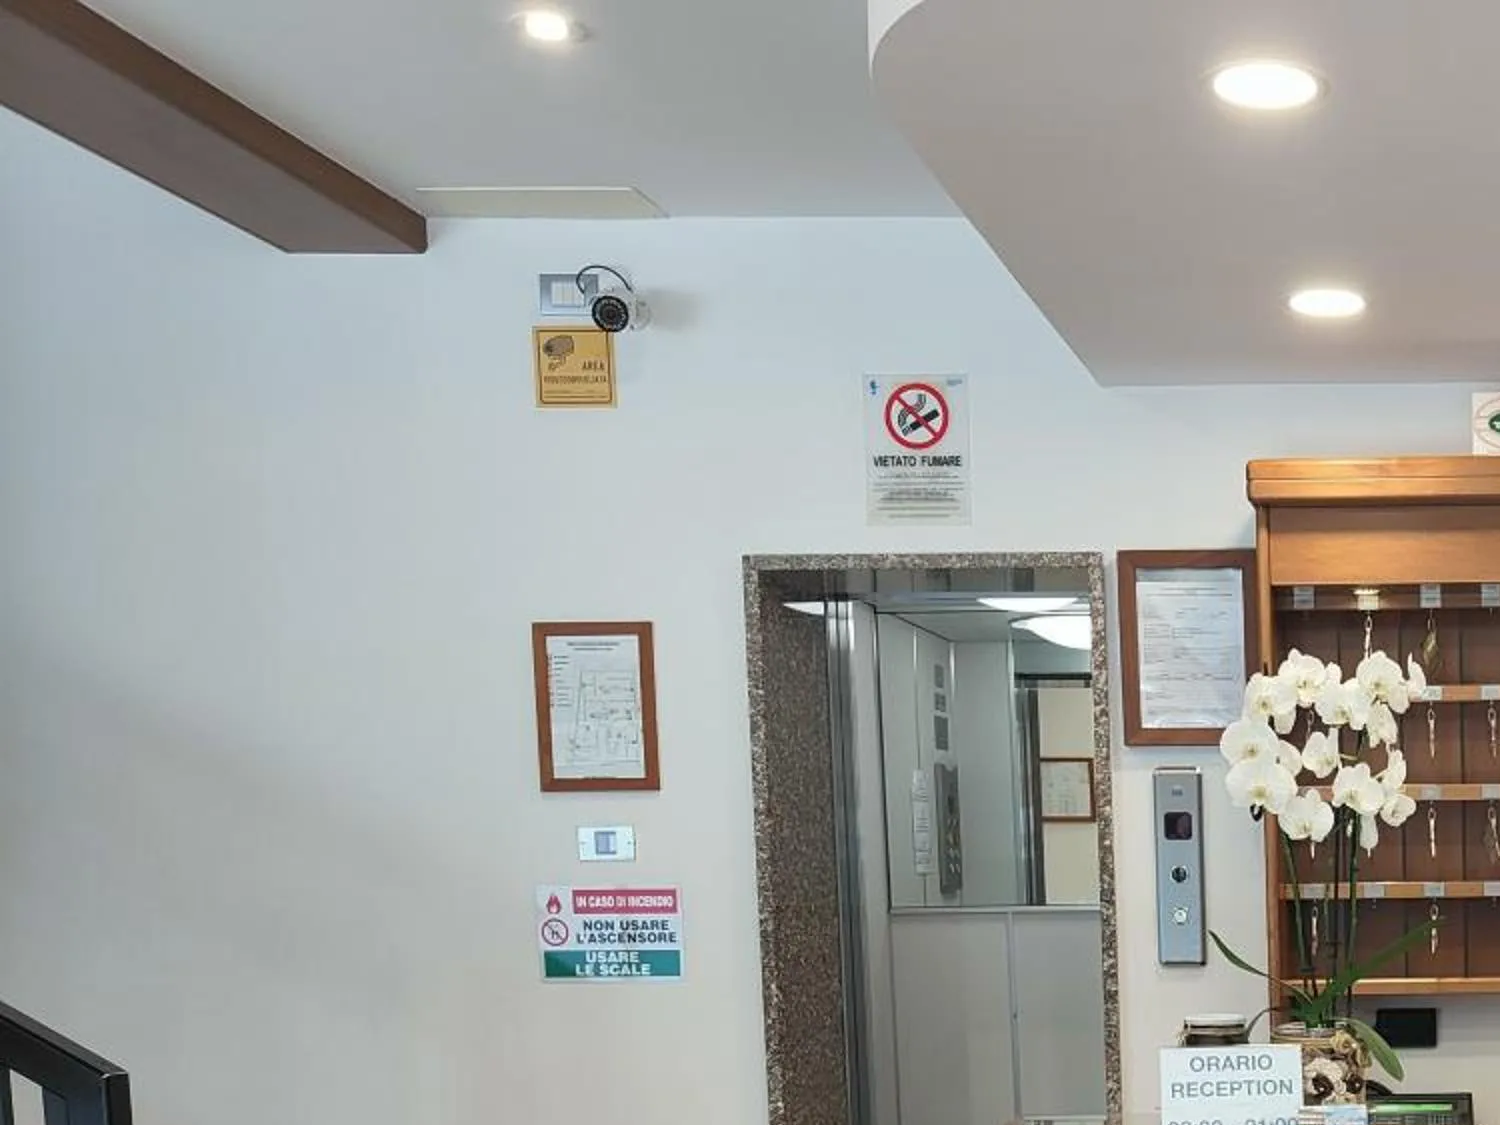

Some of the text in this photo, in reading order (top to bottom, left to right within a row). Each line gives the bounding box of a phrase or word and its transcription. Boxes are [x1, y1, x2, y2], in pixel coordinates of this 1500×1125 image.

[582, 360, 605, 372] AREA
[873, 455, 963, 468] VIETATO FUMARE
[575, 895, 674, 908] IN CASO DI INCENDIO
[583, 919, 670, 931] NON USARE
[576, 931, 677, 944] L'ASCENSORE
[585, 951, 640, 963] USARE
[575, 963, 652, 976] LE SCALE
[1189, 1053, 1273, 1073] ORARIO
[1170, 1079, 1294, 1099] RECEPTION
